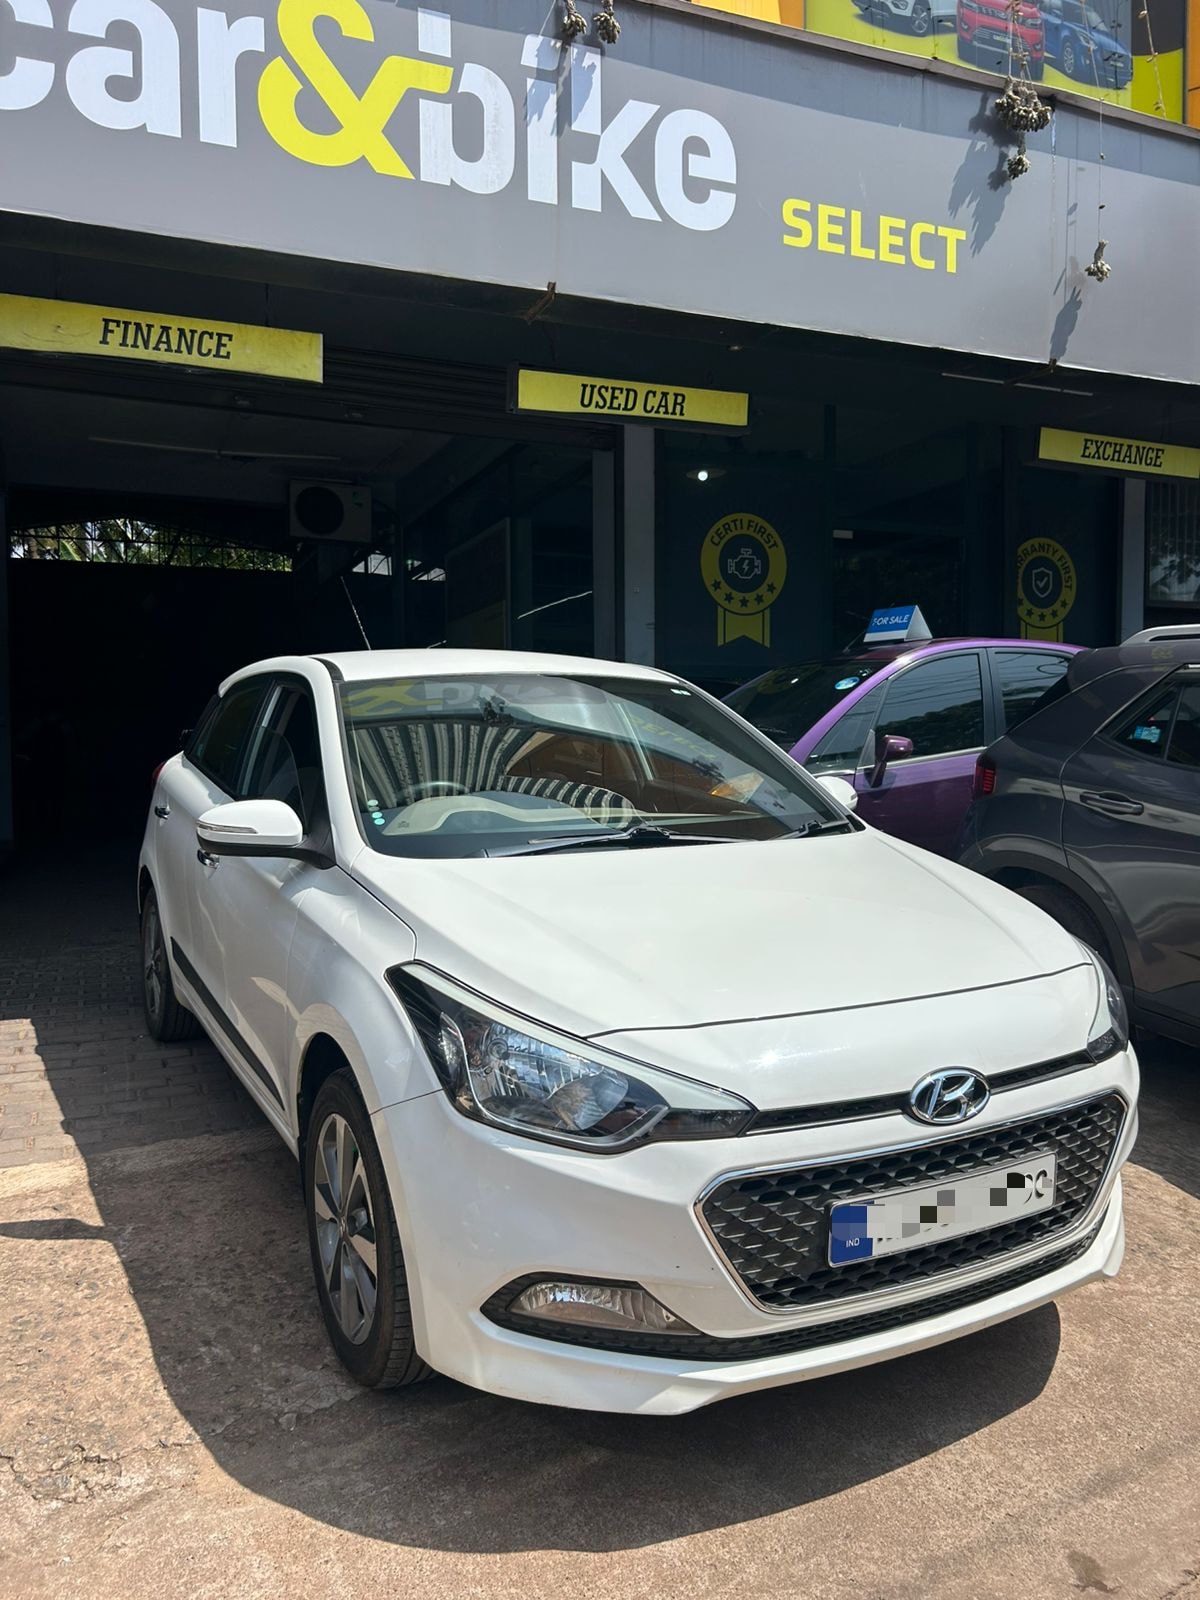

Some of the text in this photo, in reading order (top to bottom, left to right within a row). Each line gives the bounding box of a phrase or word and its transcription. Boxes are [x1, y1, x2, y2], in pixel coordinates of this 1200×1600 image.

[782, 198, 966, 273] SELECT
[99, 317, 233, 360] FINANCE
[580, 383, 686, 417] USED CAR
[1081, 438, 1165, 468] EXCHANGE
[710, 518, 779, 550] CERTI FIRST
[1056, 554, 1073, 592] FIRST
[872, 614, 911, 627] FOR SALE
